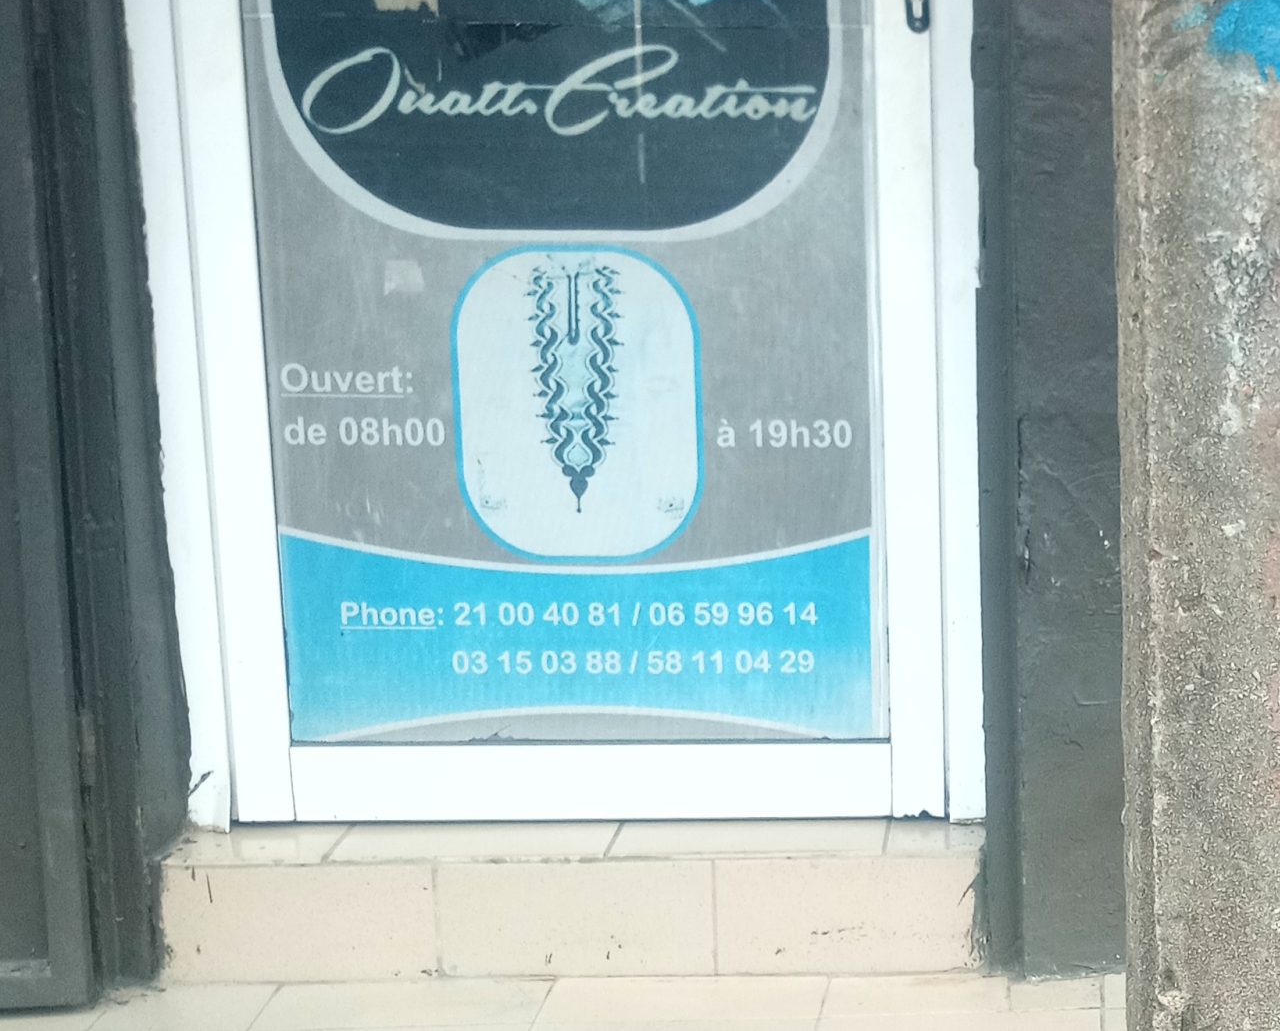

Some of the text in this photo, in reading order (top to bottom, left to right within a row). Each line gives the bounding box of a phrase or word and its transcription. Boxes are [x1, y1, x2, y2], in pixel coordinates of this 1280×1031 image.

[280, 362, 414, 398] Ouvert:
[284, 417, 446, 447] de 08h00
[716, 418, 853, 449] à 19h30
[340, 601, 818, 630] Phone: 21 00 40 81 / 06 59 96 14
[452, 649, 815, 675] 03 15 03 88 / 58 11 04 29
